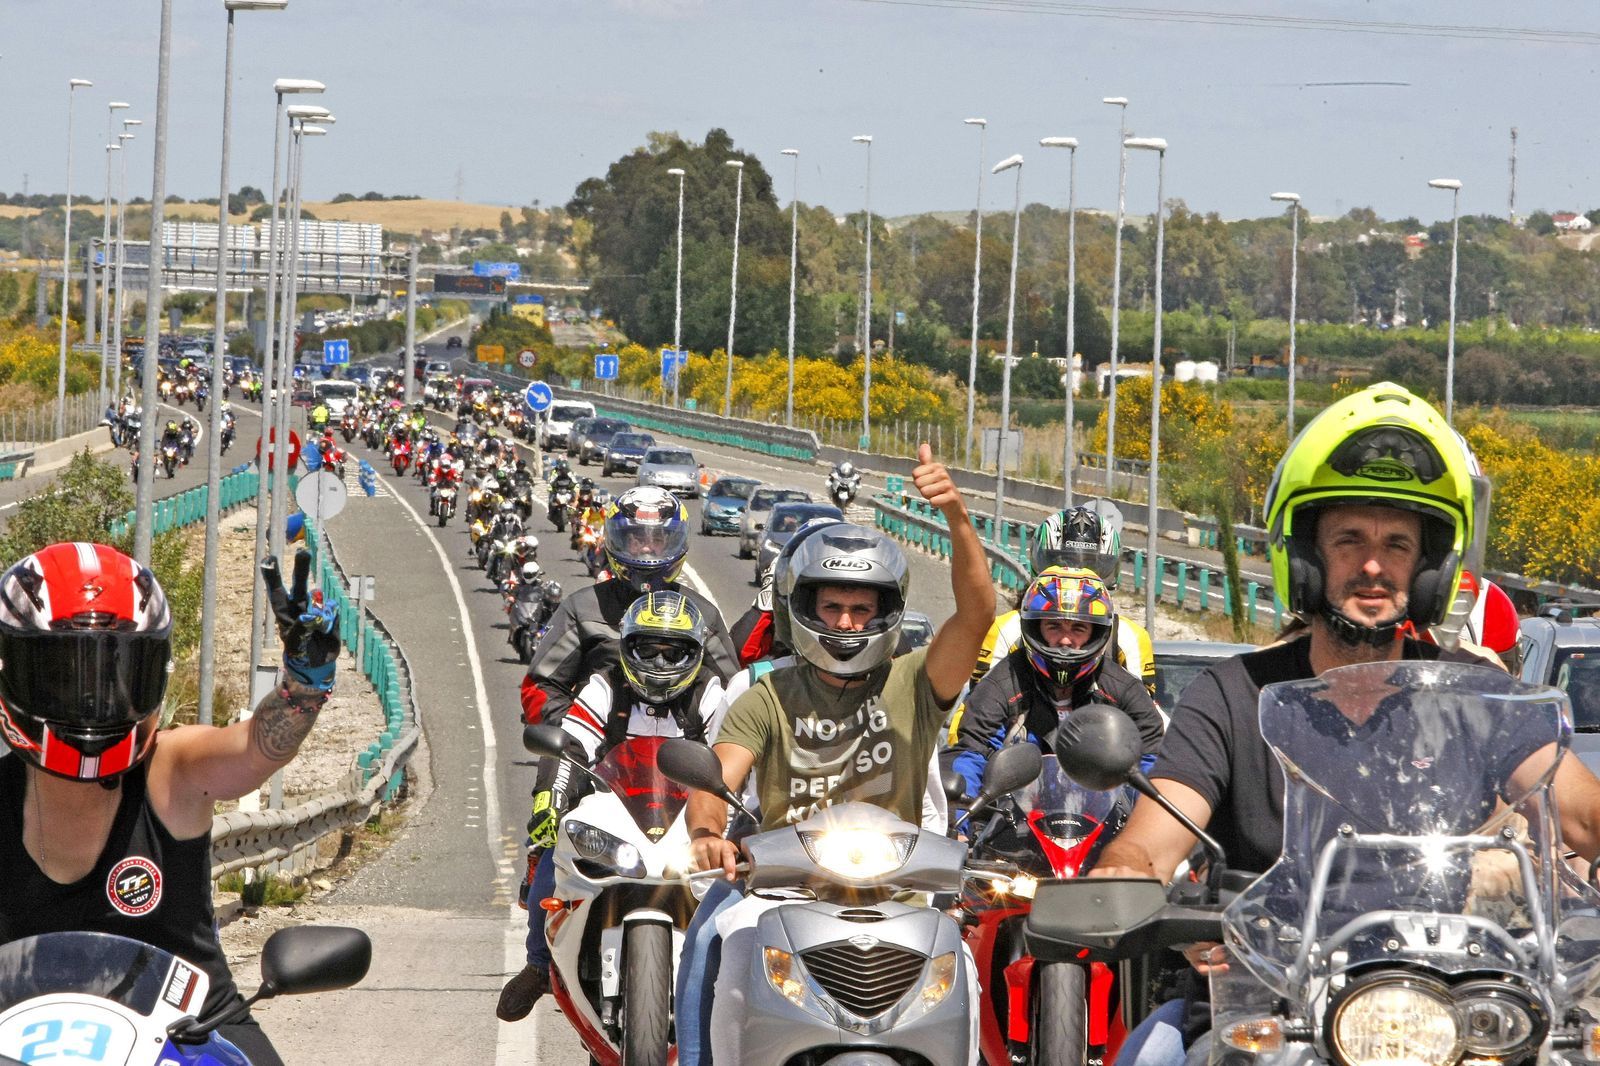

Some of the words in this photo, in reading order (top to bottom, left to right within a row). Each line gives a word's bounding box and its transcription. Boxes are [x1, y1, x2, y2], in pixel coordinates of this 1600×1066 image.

[828, 559, 865, 569] HJC
[1050, 818, 1082, 828] HONDA
[131, 893, 149, 905] 2017
[20, 1019, 112, 1064] 23
